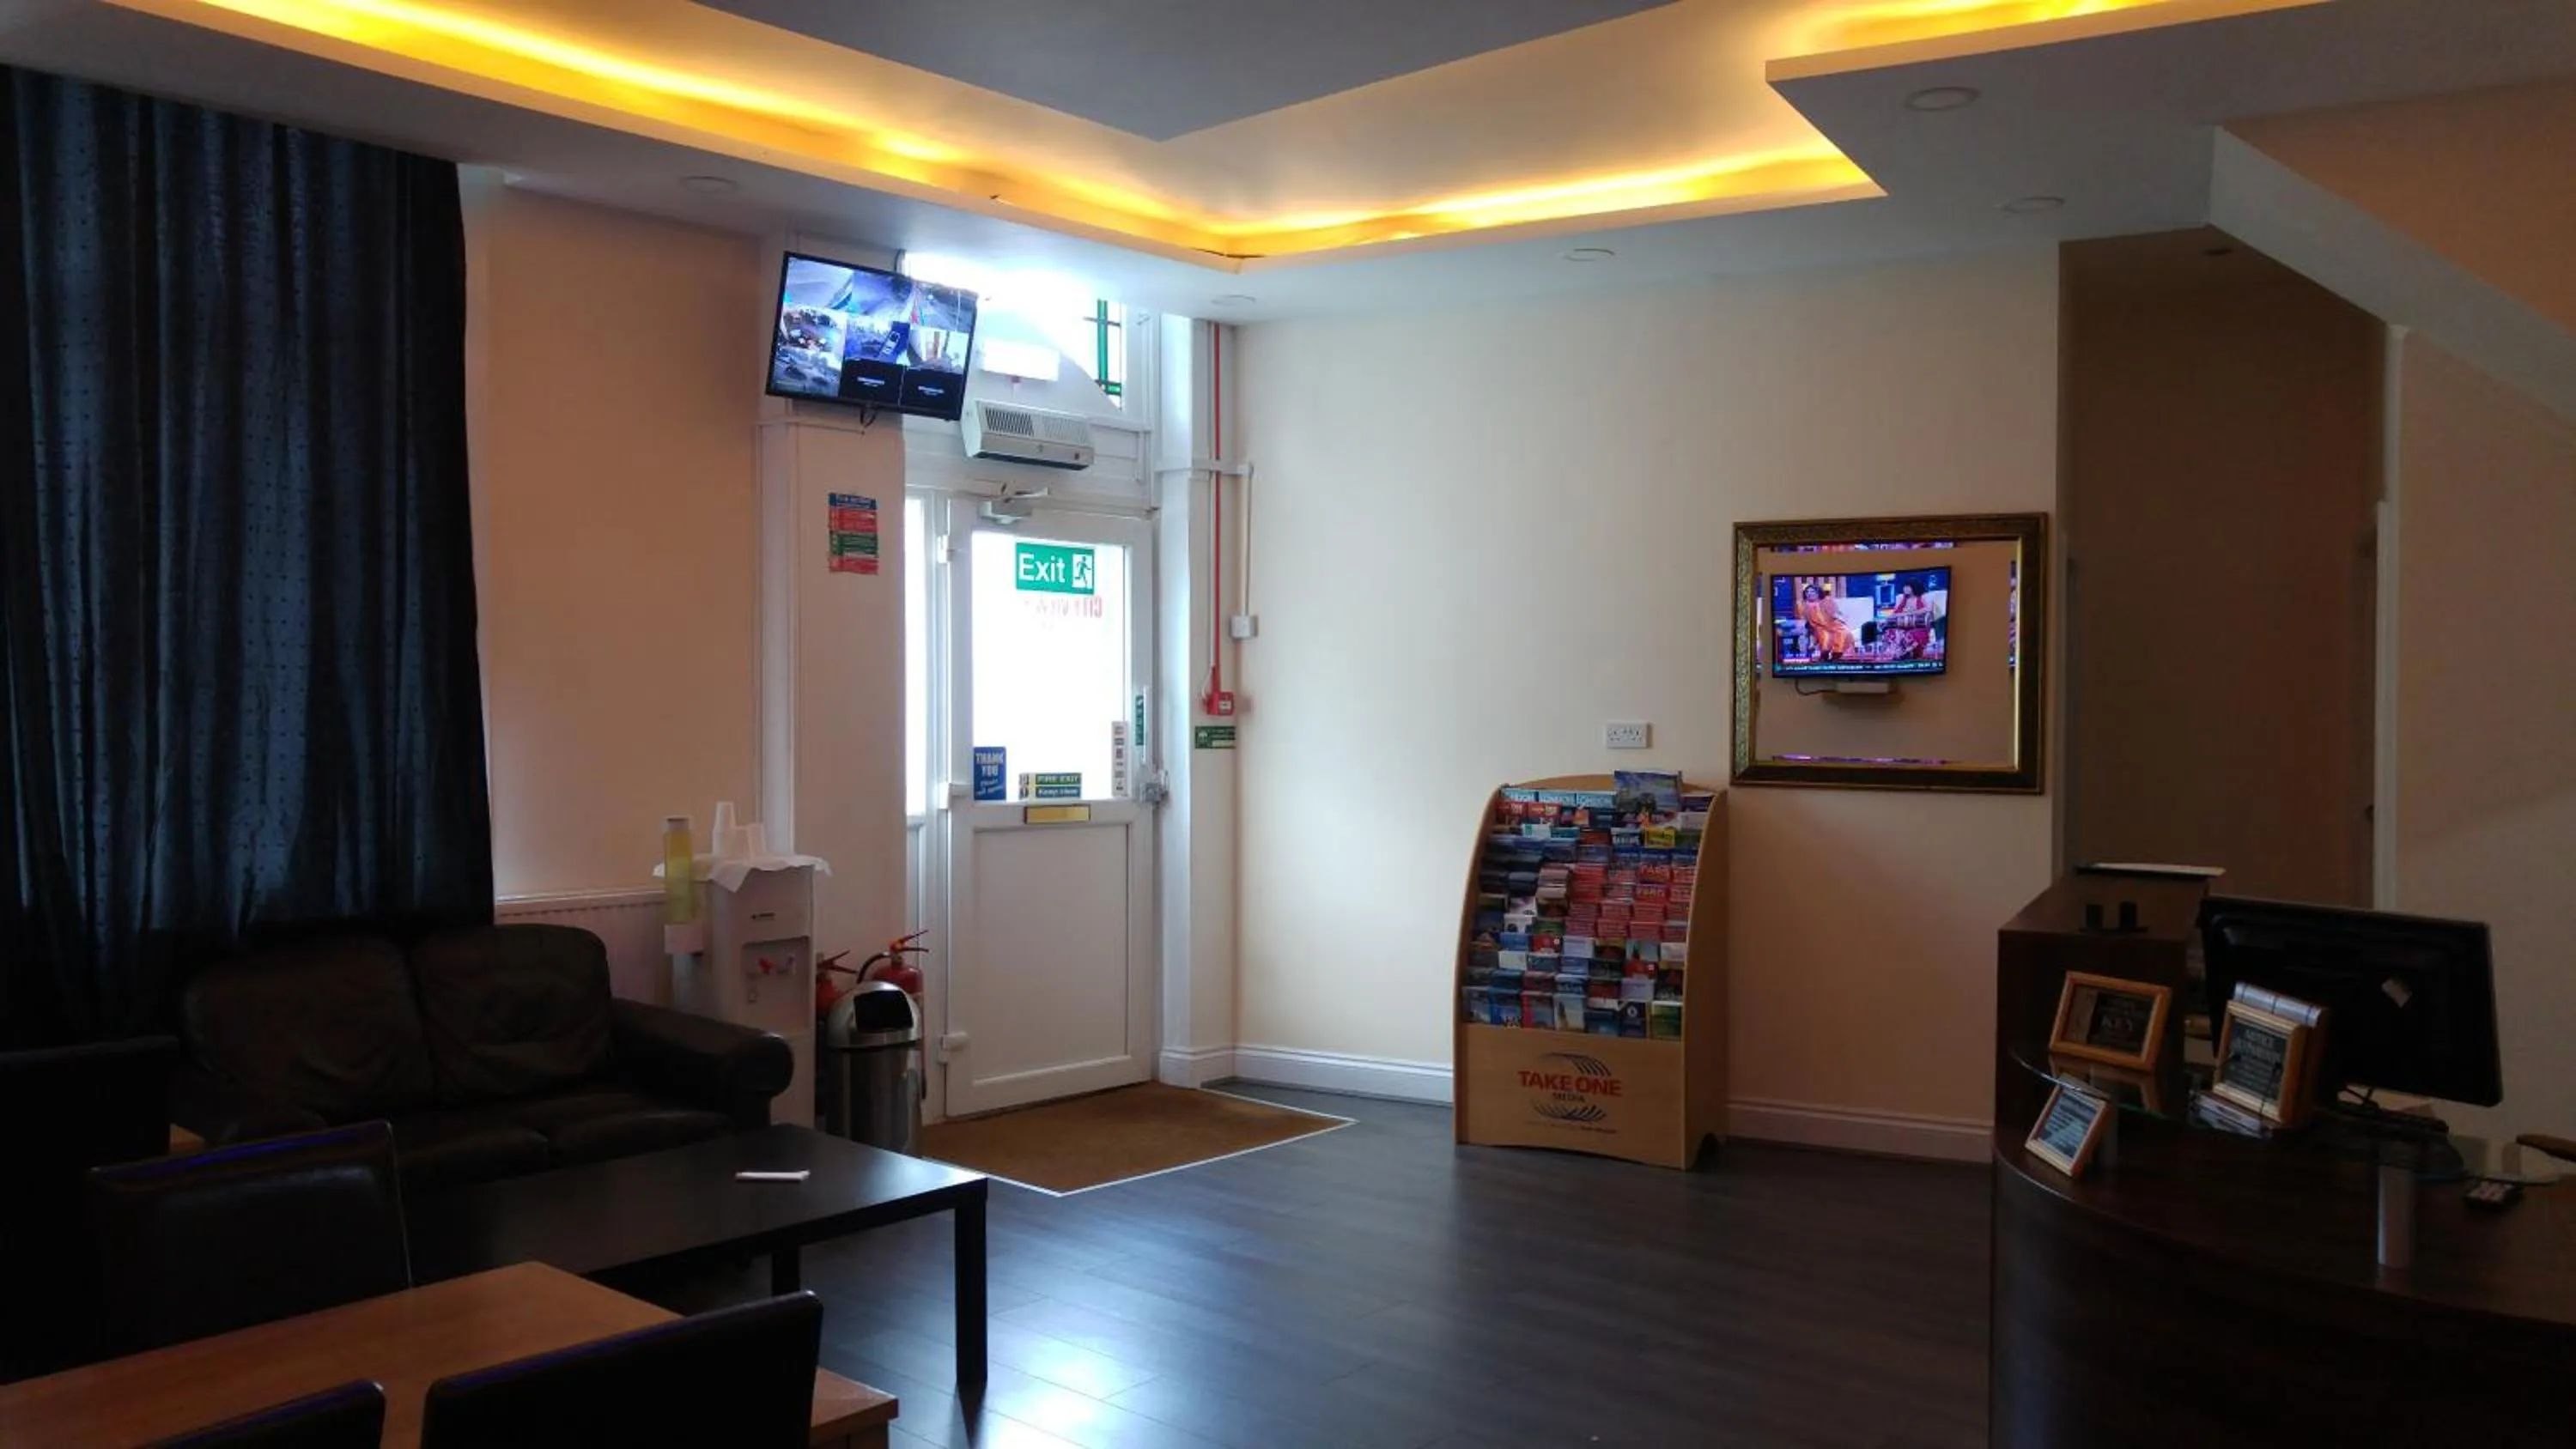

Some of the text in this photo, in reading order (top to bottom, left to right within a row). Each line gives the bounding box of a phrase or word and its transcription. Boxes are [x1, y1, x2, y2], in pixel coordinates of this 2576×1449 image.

[1018, 552, 1066, 583] Exit
[981, 765, 999, 776] YOU
[1060, 774, 1078, 783] EXIT
[1517, 1070, 1623, 1097] TAKE ONE
